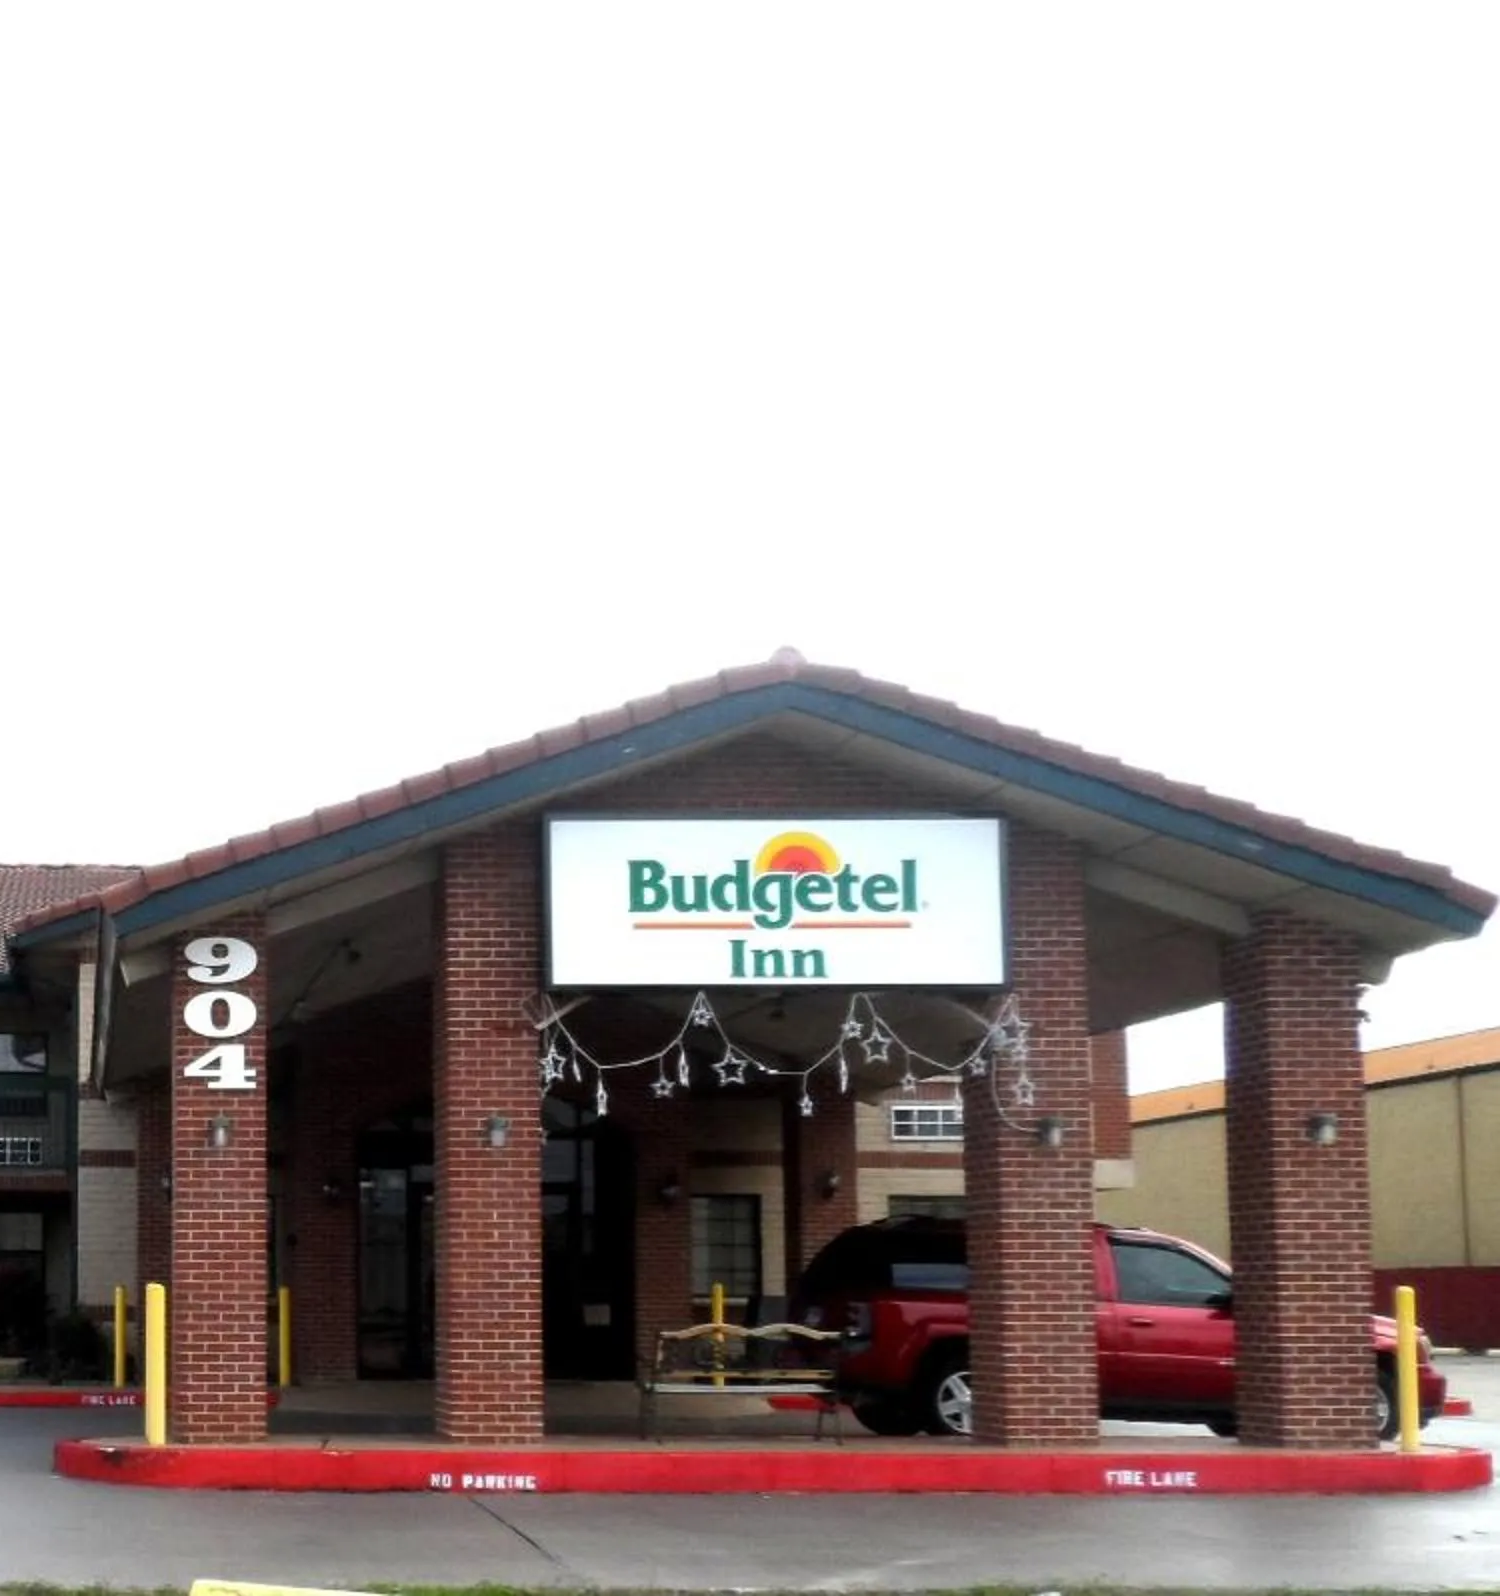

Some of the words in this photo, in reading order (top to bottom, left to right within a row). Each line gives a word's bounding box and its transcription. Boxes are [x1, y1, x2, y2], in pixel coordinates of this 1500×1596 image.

[627, 858, 918, 930] Budgetel
[728, 938, 829, 979] Inn
[183, 936, 258, 1089] 904
[429, 1472, 452, 1488] NO
[461, 1473, 537, 1490] PARKING
[1105, 1469, 1145, 1488] FIRE
[1150, 1470, 1198, 1488] LANE
